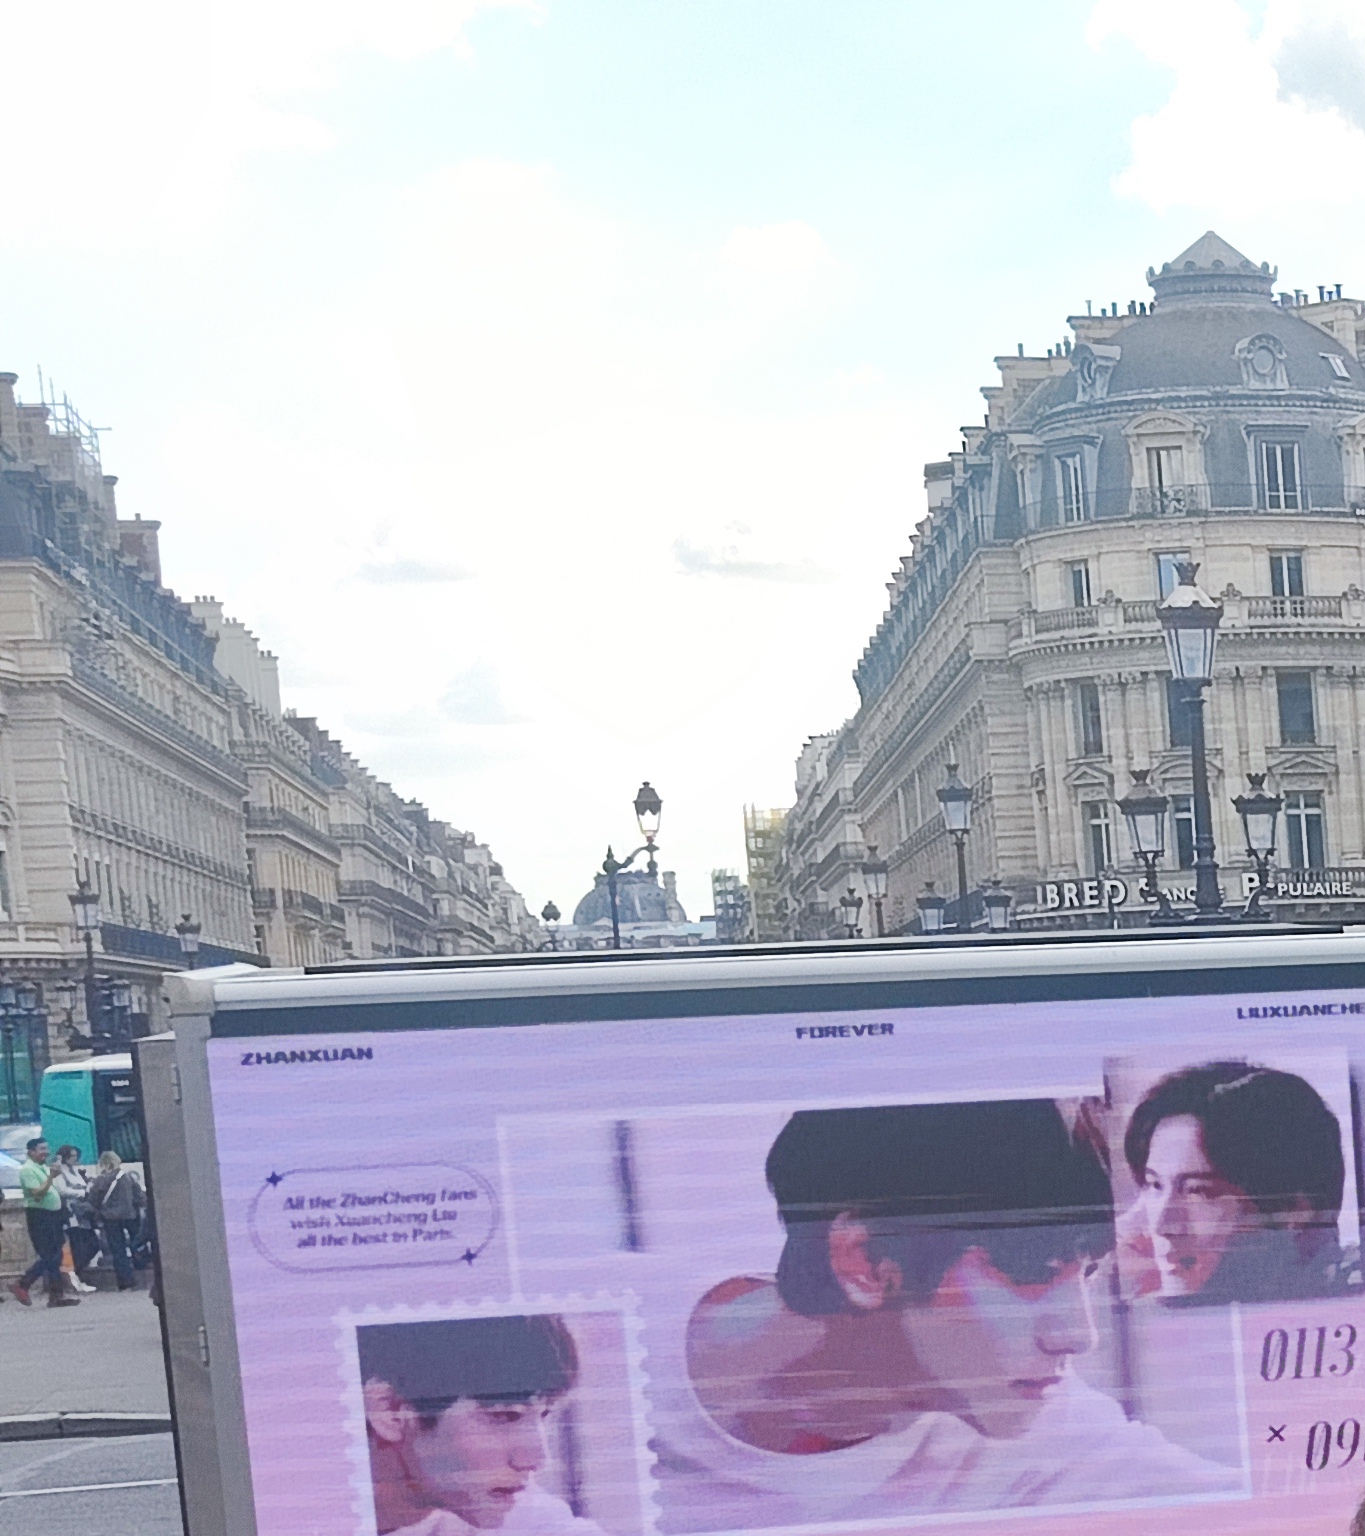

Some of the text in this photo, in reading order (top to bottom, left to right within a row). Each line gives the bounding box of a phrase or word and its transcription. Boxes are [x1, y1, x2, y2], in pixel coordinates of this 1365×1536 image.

[795, 1022, 895, 1040] FOREVER
[240, 1047, 374, 1066] ZHANXUAN
[1260, 1323, 1357, 1382] 0113
